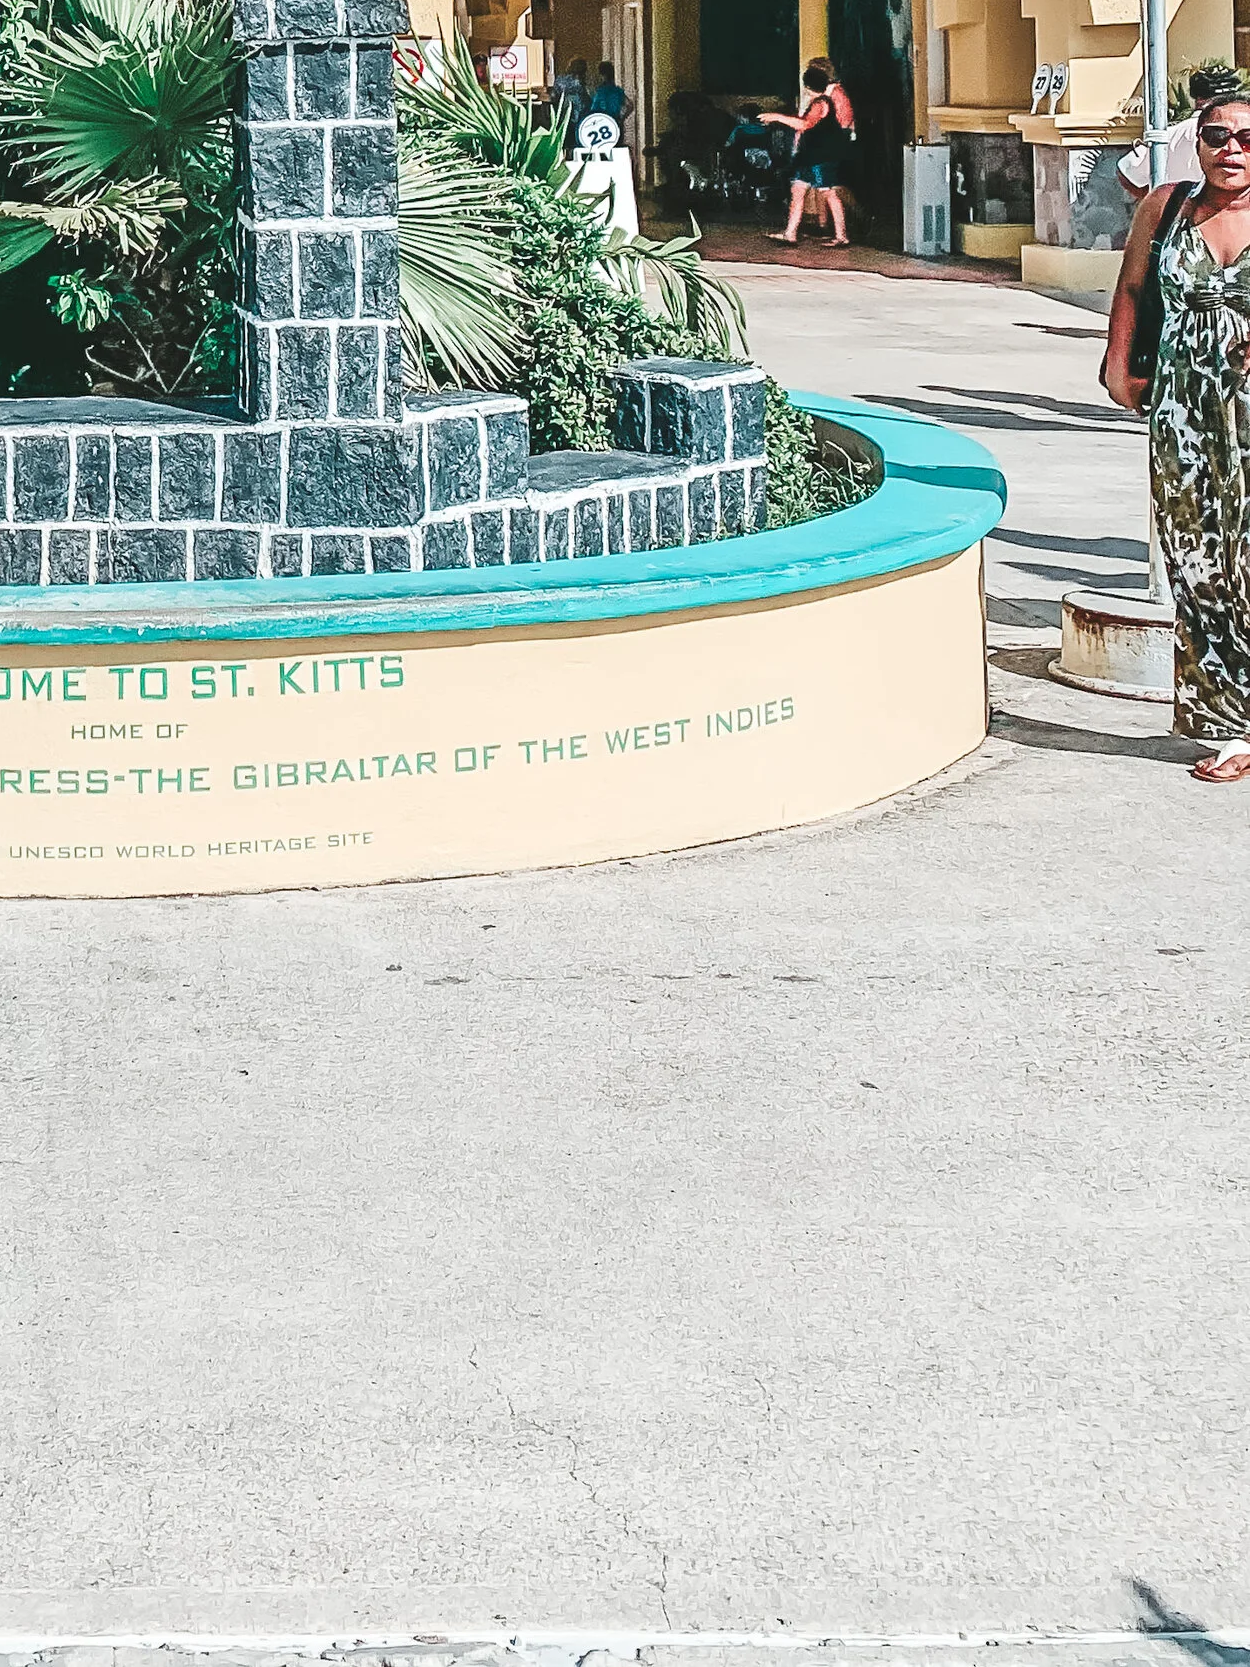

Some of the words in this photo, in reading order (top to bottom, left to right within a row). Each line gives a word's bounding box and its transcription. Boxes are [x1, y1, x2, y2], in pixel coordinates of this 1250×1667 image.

[1035, 77, 1047, 89] 27
[587, 125, 613, 146] 28
[109, 667, 168, 701] TO
[191, 665, 254, 699] ST.
[279, 656, 405, 695] KITTS
[71, 723, 143, 740] HOME
[156, 723, 189, 739] OF
[233, 751, 438, 790] GIBRALTAR
[454, 744, 502, 773] OF
[517, 734, 589, 765] THE
[605, 718, 691, 755] WEST
[706, 696, 795, 738] INDIES
[9, 845, 104, 859] UNESCO
[116, 845, 196, 859] WORLD
[207, 836, 316, 857] HERITAGE
[327, 831, 374, 848] SITE
